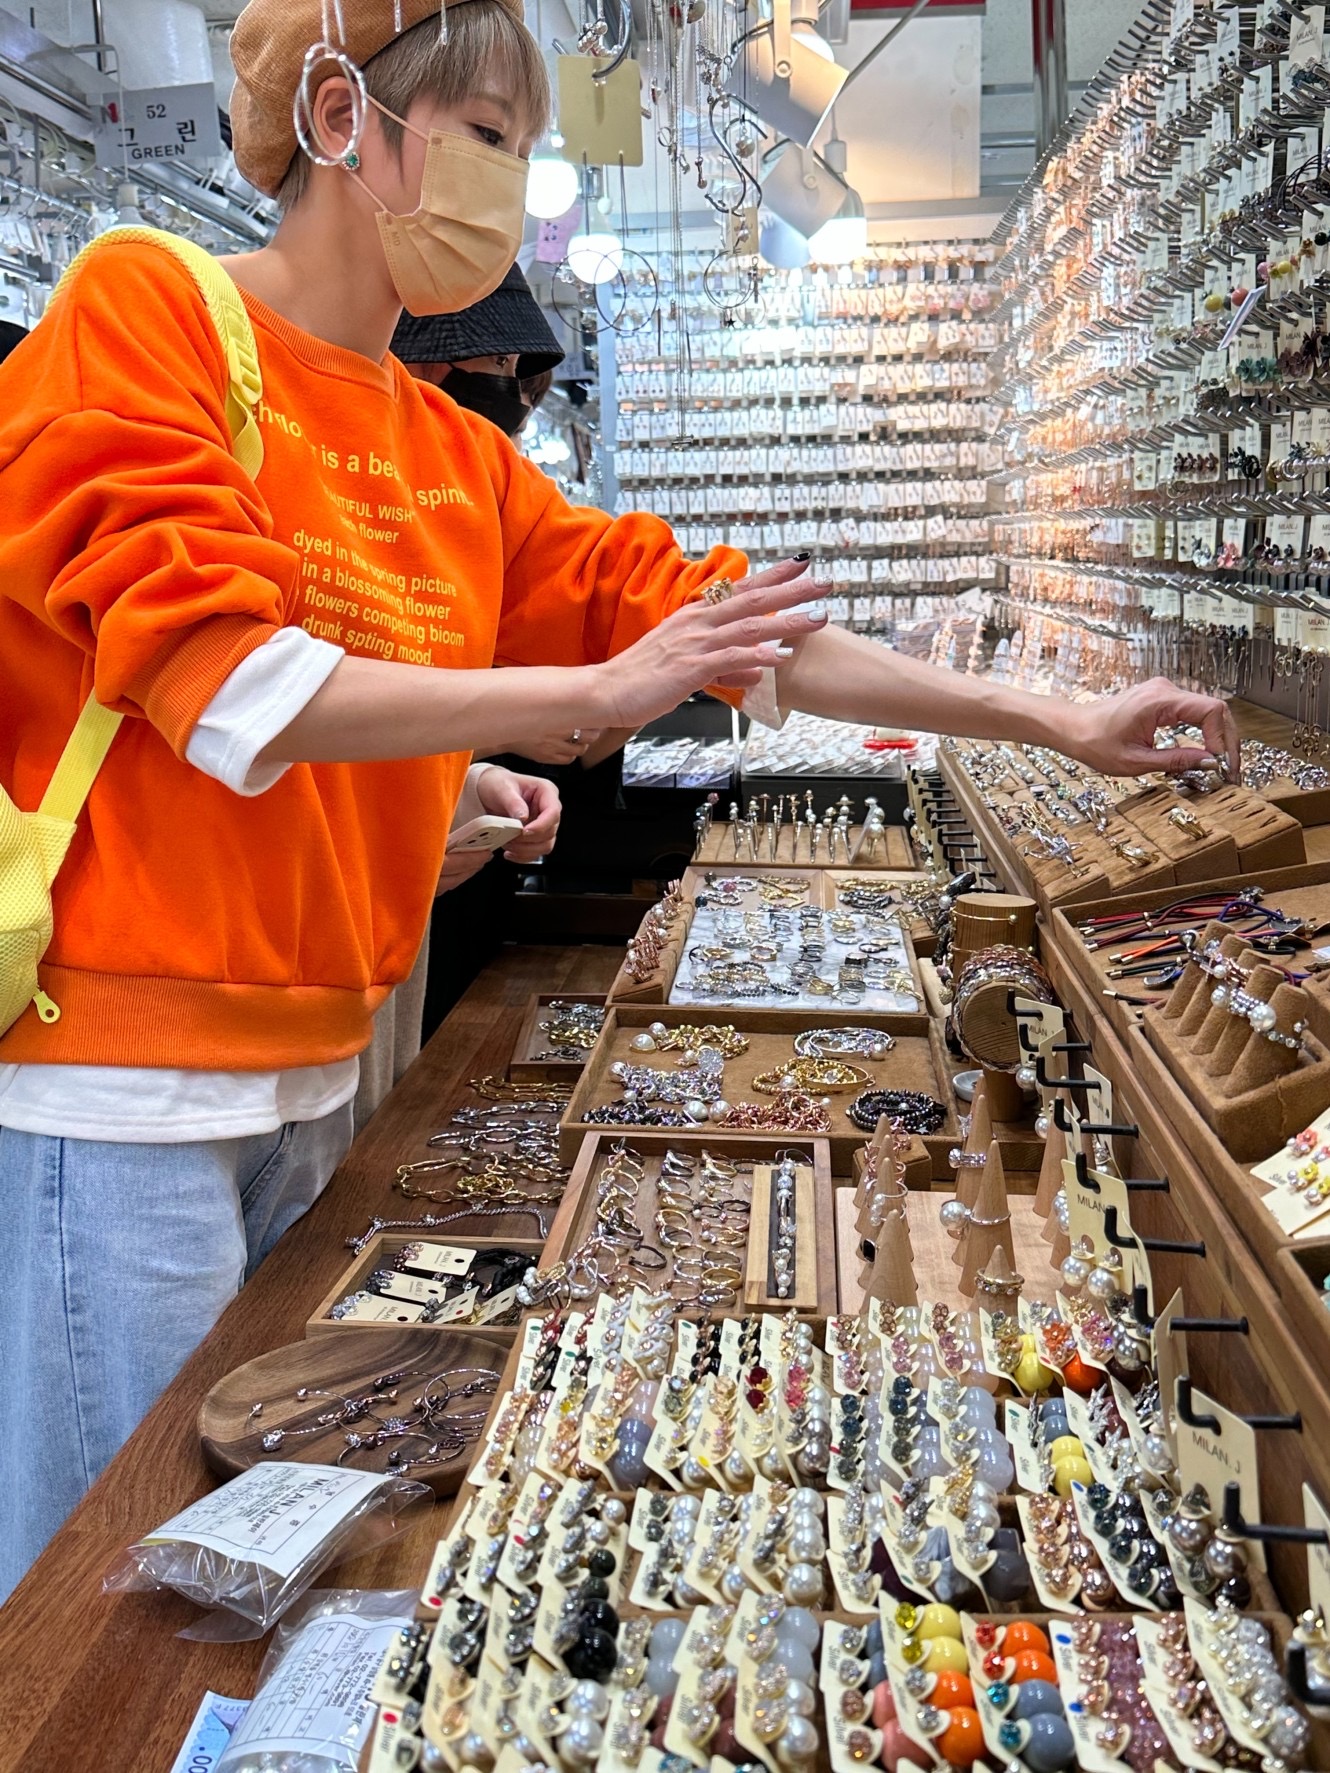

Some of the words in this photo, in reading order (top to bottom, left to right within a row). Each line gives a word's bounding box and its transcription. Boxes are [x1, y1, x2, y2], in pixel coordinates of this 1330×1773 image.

[146, 104, 166, 119] 52
[132, 144, 186, 159] GREEN
[321, 444, 339, 469] is
[346, 453, 360, 473] a
[359, 522, 399, 544] flower
[293, 529, 332, 556] dyed
[335, 541, 348, 562] in
[350, 549, 368, 571] the
[369, 564, 406, 593] spring
[411, 574, 457, 598] picture
[302, 557, 318, 579] in
[322, 567, 331, 583] a
[335, 567, 404, 615] blossoming
[405, 596, 451, 620] flower
[304, 585, 359, 618] flowers
[362, 607, 426, 644] competing
[301, 614, 344, 640] drunk
[397, 644, 435, 667] mood.
